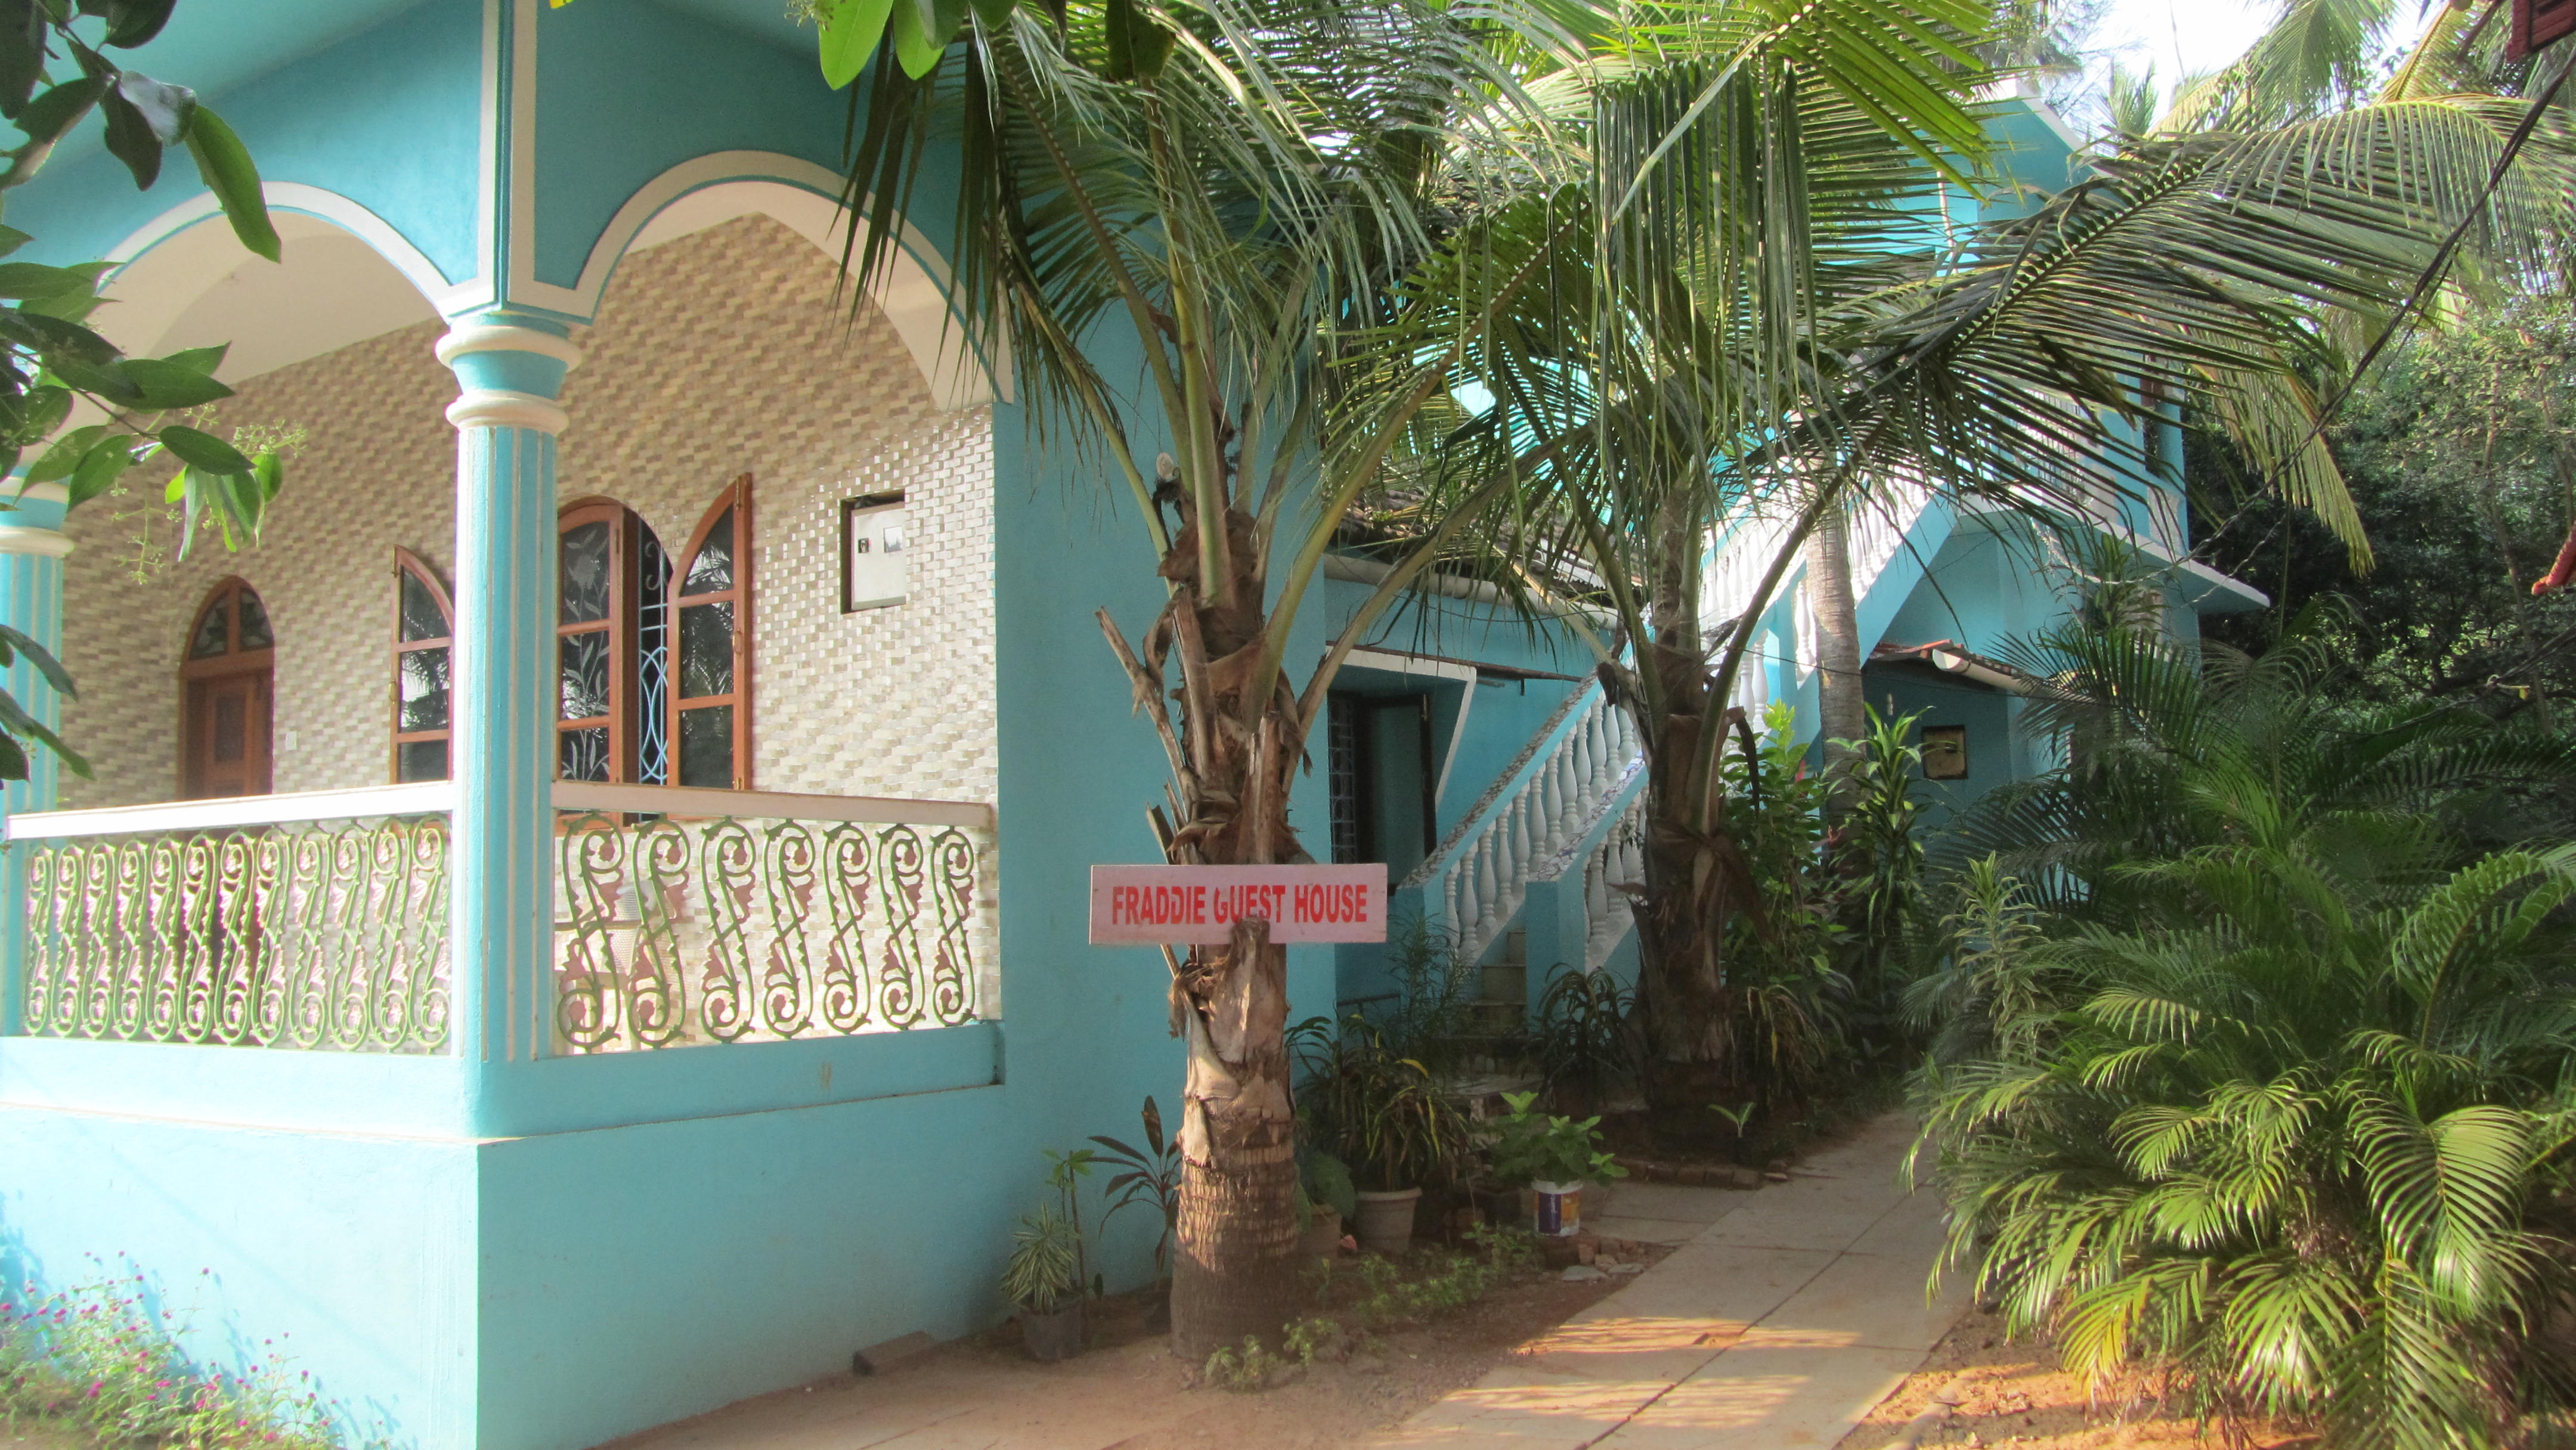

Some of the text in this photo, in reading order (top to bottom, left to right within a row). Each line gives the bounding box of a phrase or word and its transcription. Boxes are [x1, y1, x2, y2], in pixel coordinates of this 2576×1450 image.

[1112, 884, 1368, 925] FRADDIE GUEST HOUSE
